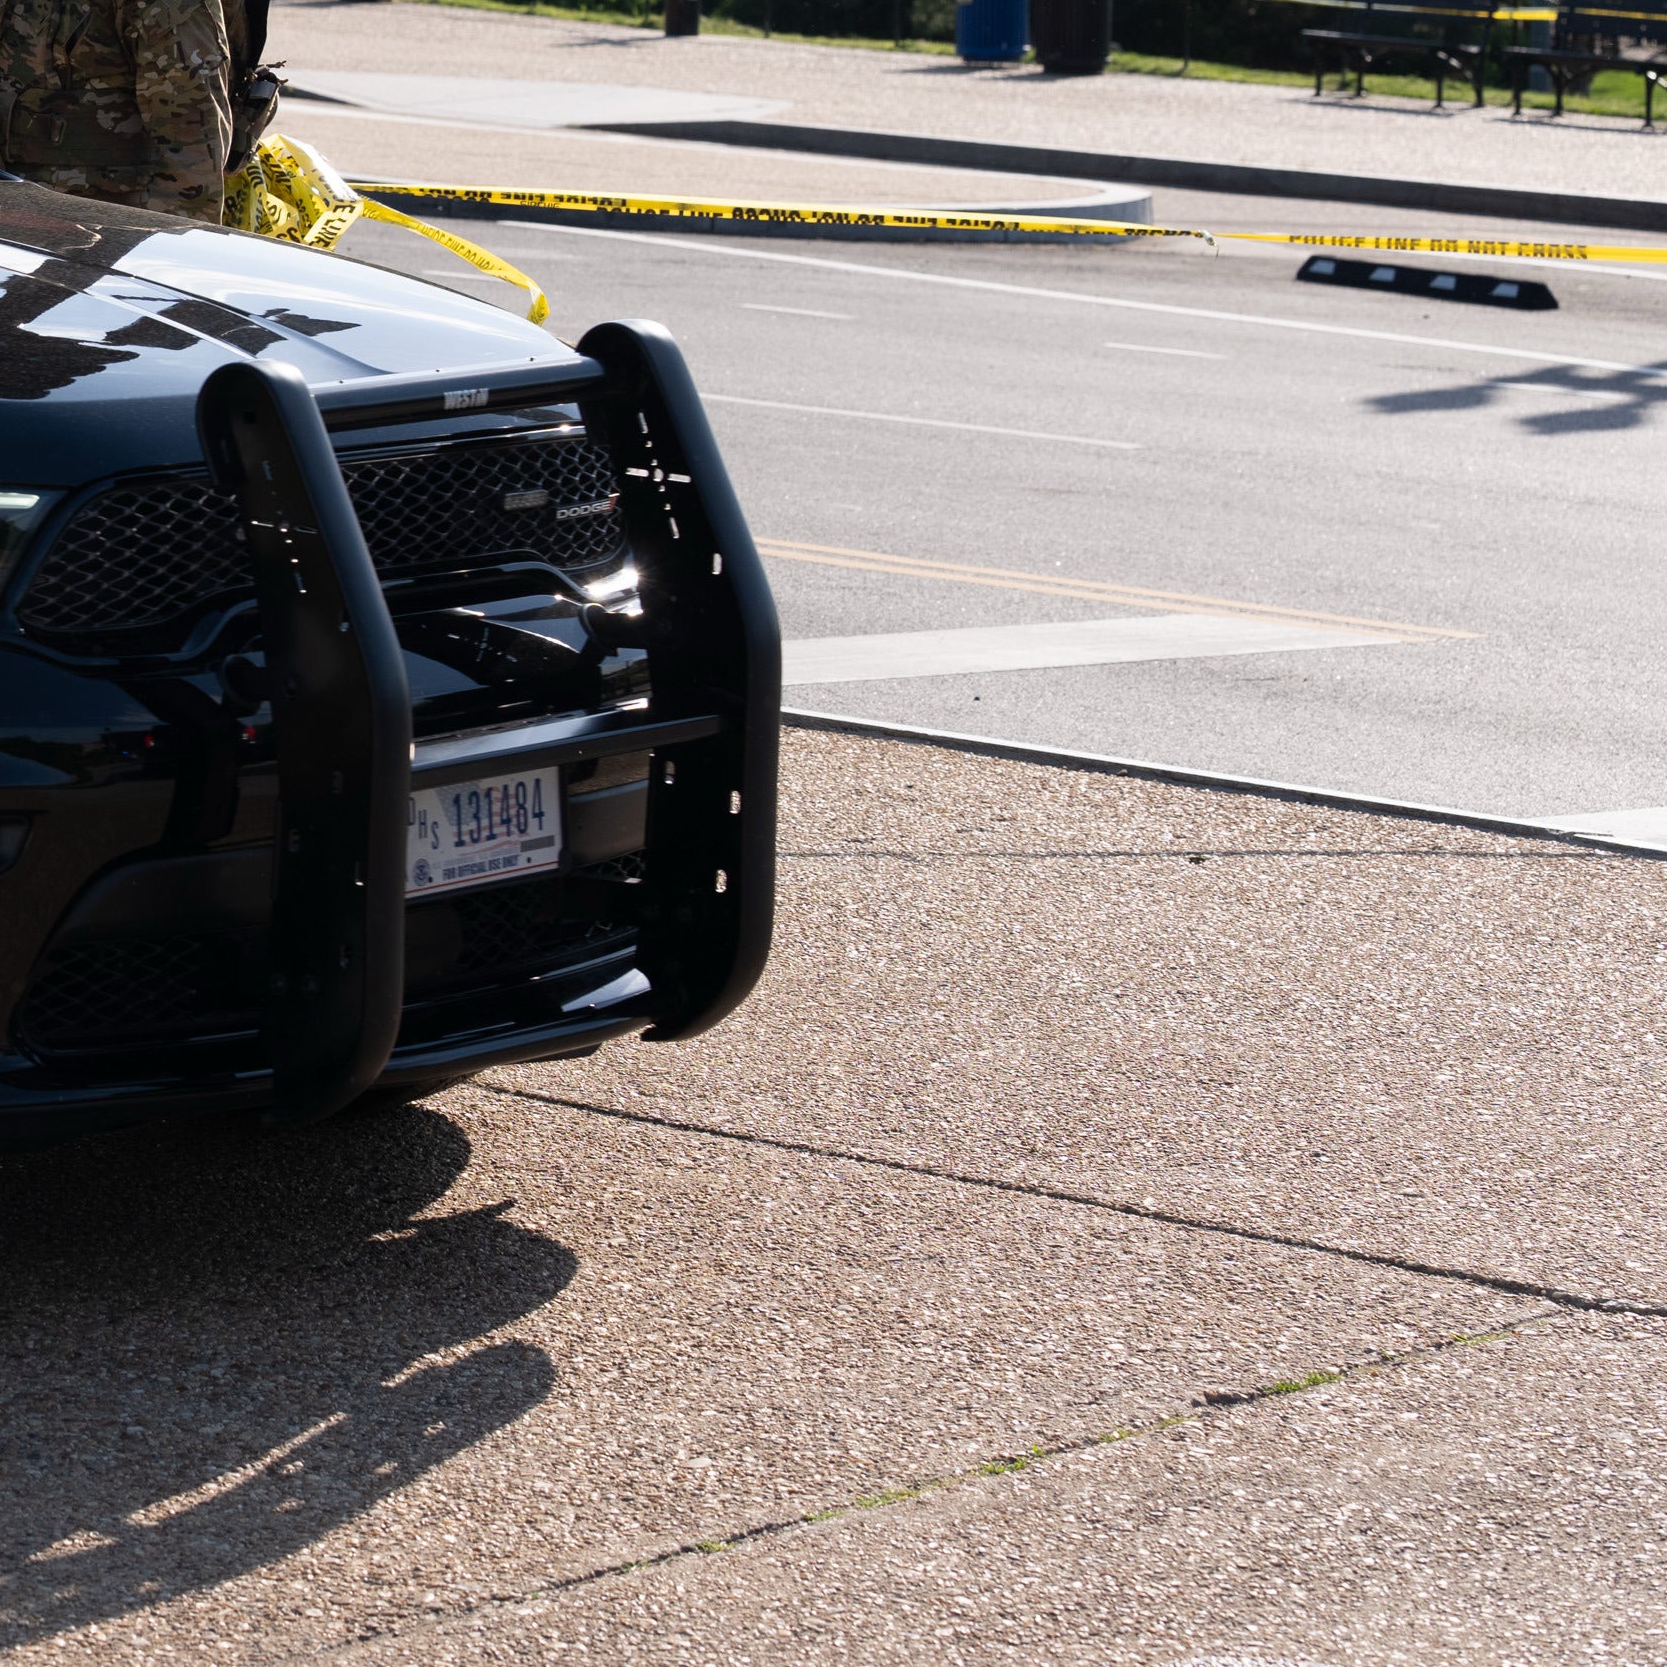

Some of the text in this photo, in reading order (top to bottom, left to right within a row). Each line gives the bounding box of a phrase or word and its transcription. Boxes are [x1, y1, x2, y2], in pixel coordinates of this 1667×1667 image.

[1289, 235, 1588, 259] POLICE LINE DO NOT CROSS
[444, 388, 489, 411] WESTIN
[555, 500, 612, 520] DODGE
[453, 778, 545, 848] 131484
